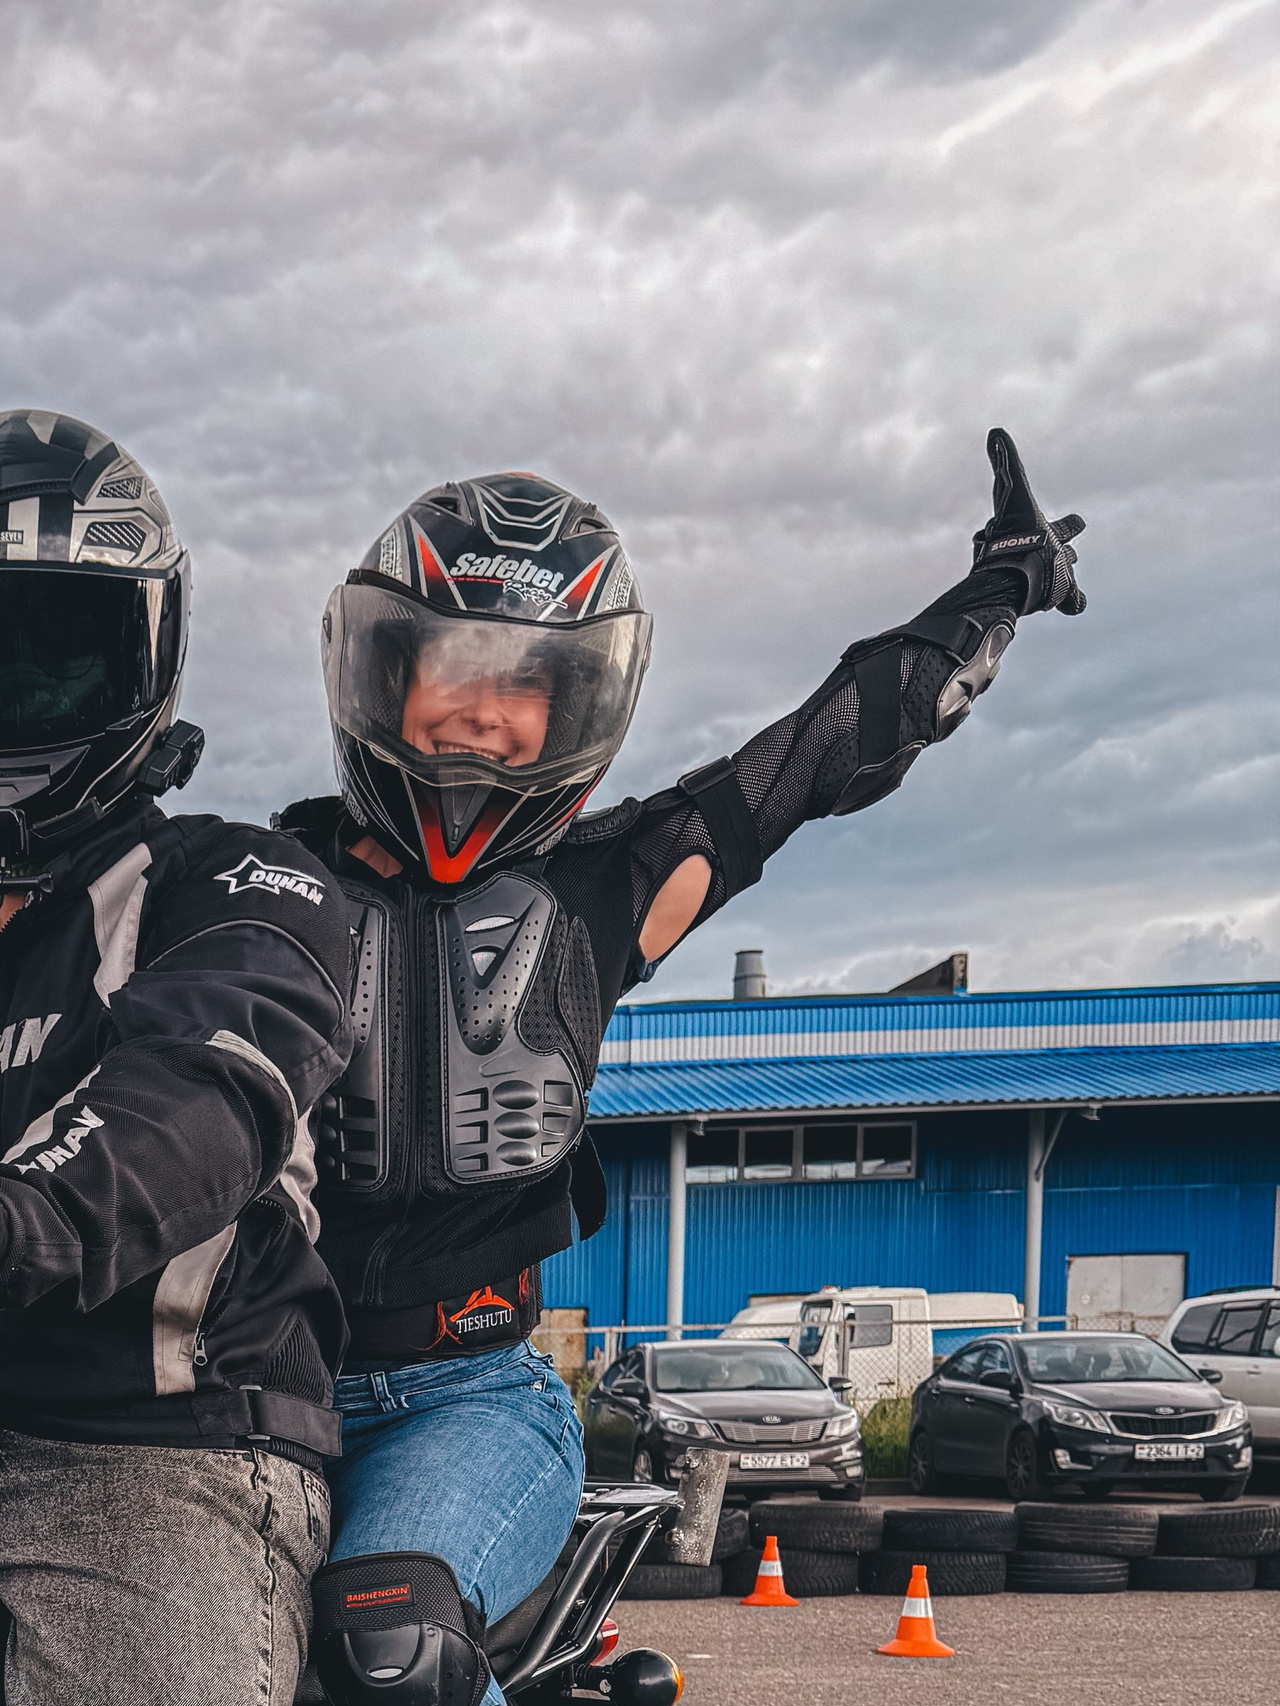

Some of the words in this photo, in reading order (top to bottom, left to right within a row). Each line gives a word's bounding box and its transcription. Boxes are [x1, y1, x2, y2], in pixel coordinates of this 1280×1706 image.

[991, 535, 1040, 551] SUOMY
[449, 552, 564, 593] Safebet
[248, 869, 324, 906] DUHAN
[456, 1308, 512, 1334] TIESHUTU
